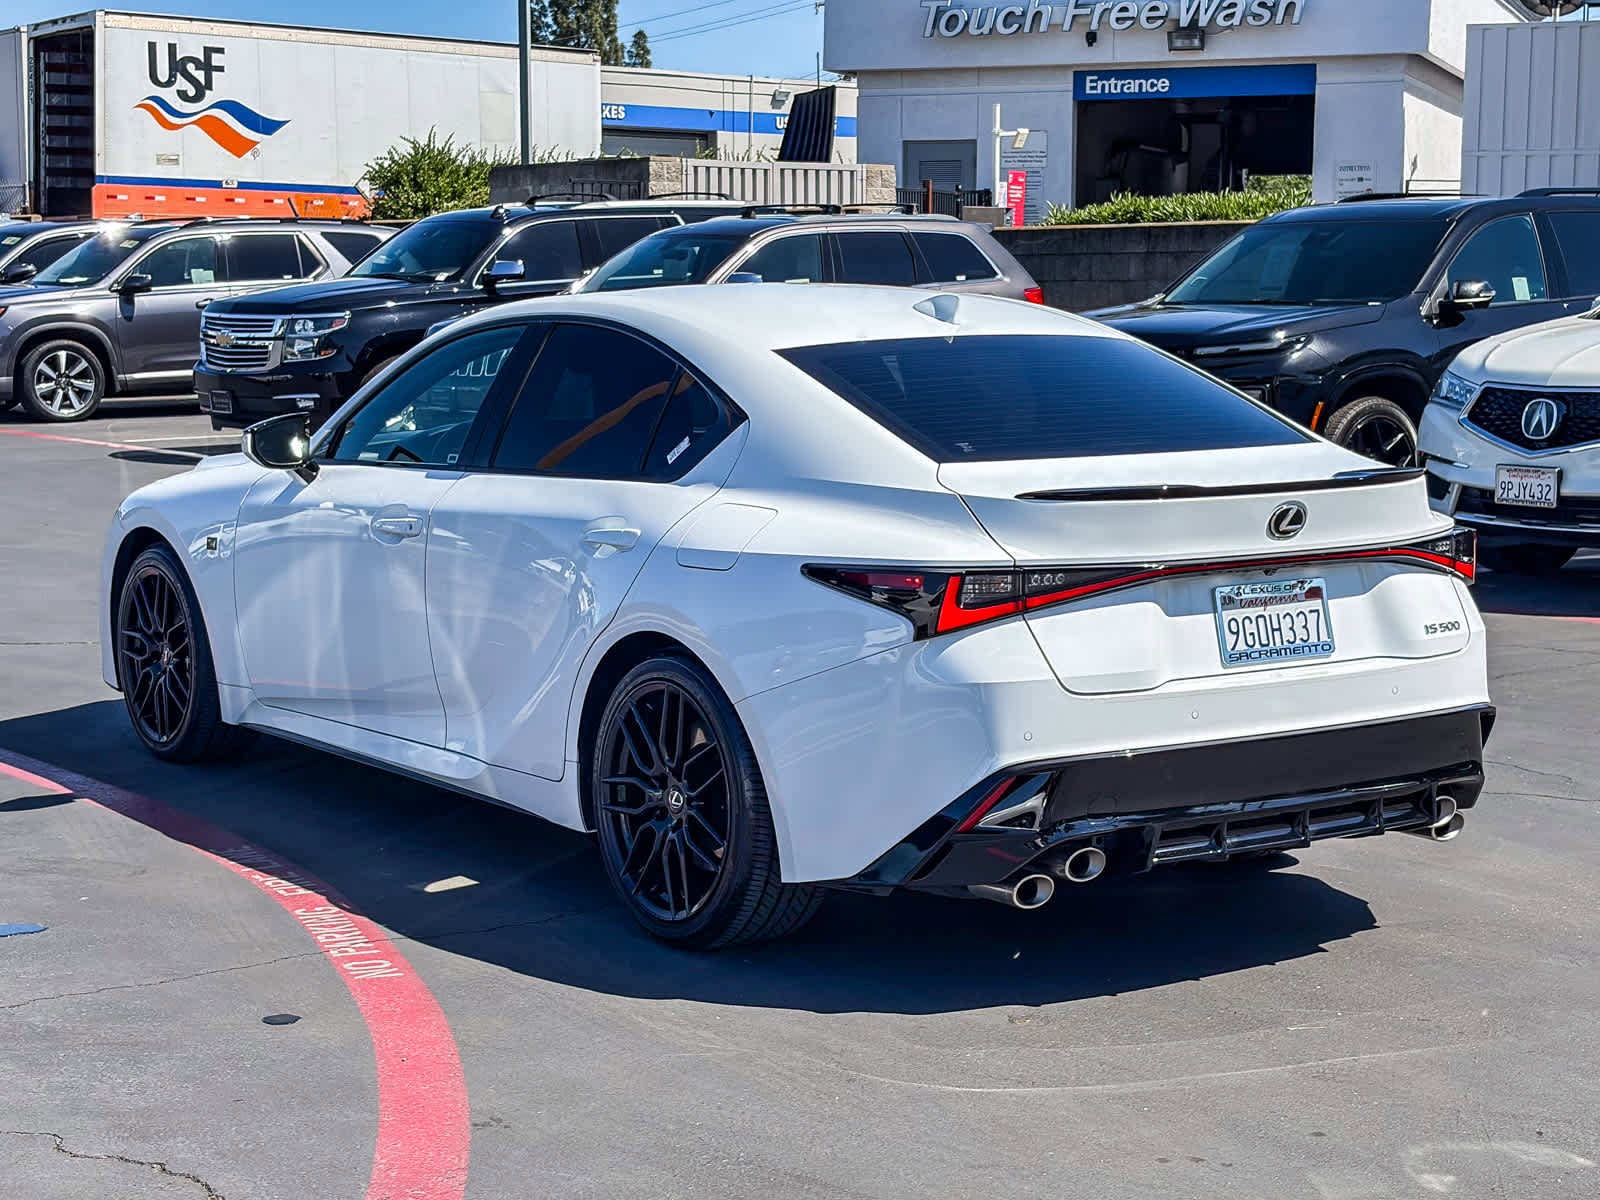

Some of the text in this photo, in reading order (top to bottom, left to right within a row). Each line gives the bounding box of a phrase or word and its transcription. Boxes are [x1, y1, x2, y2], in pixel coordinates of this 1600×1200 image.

[920, 0, 1304, 38] Touch Free Wash
[147, 41, 226, 104] USF
[1085, 75, 1170, 95] Entrance
[602, 105, 626, 119] KES
[1500, 480, 1552, 502] 9PJY432
[1242, 584, 1282, 595] LEXUS
[1438, 620, 1460, 633] 500
[1228, 643, 1332, 662] SACRAMENTO
[294, 905, 381, 957] PARKING
[343, 959, 404, 979] NO
